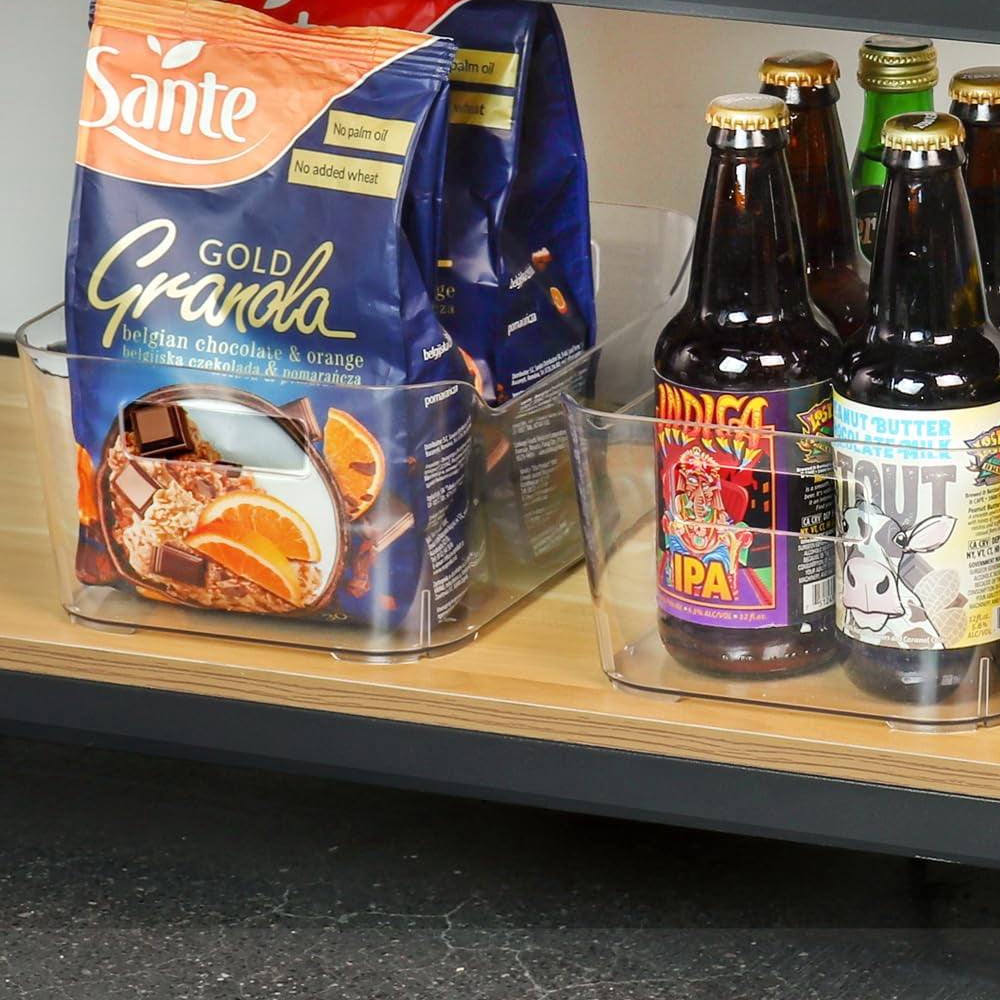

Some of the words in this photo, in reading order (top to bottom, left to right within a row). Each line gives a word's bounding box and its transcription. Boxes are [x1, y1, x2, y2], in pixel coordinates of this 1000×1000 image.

[481, 61, 496, 74] oil
[78, 45, 257, 144] Sante
[333, 122, 348, 138] No
[348, 125, 374, 143] palm
[374, 126, 389, 143] oil
[293, 160, 311, 176] No
[311, 162, 345, 180] added
[347, 168, 380, 186] wheat
[199, 239, 293, 277] GOLD
[87, 218, 357, 349] Granola
[122, 323, 189, 351] belgian
[195, 335, 284, 361] chocolate
[289, 345, 301, 362] &
[306, 350, 365, 371] orange
[264, 362, 279, 378] &
[870, 415, 953, 438] BUTTER
[672, 553, 734, 601] IPA
